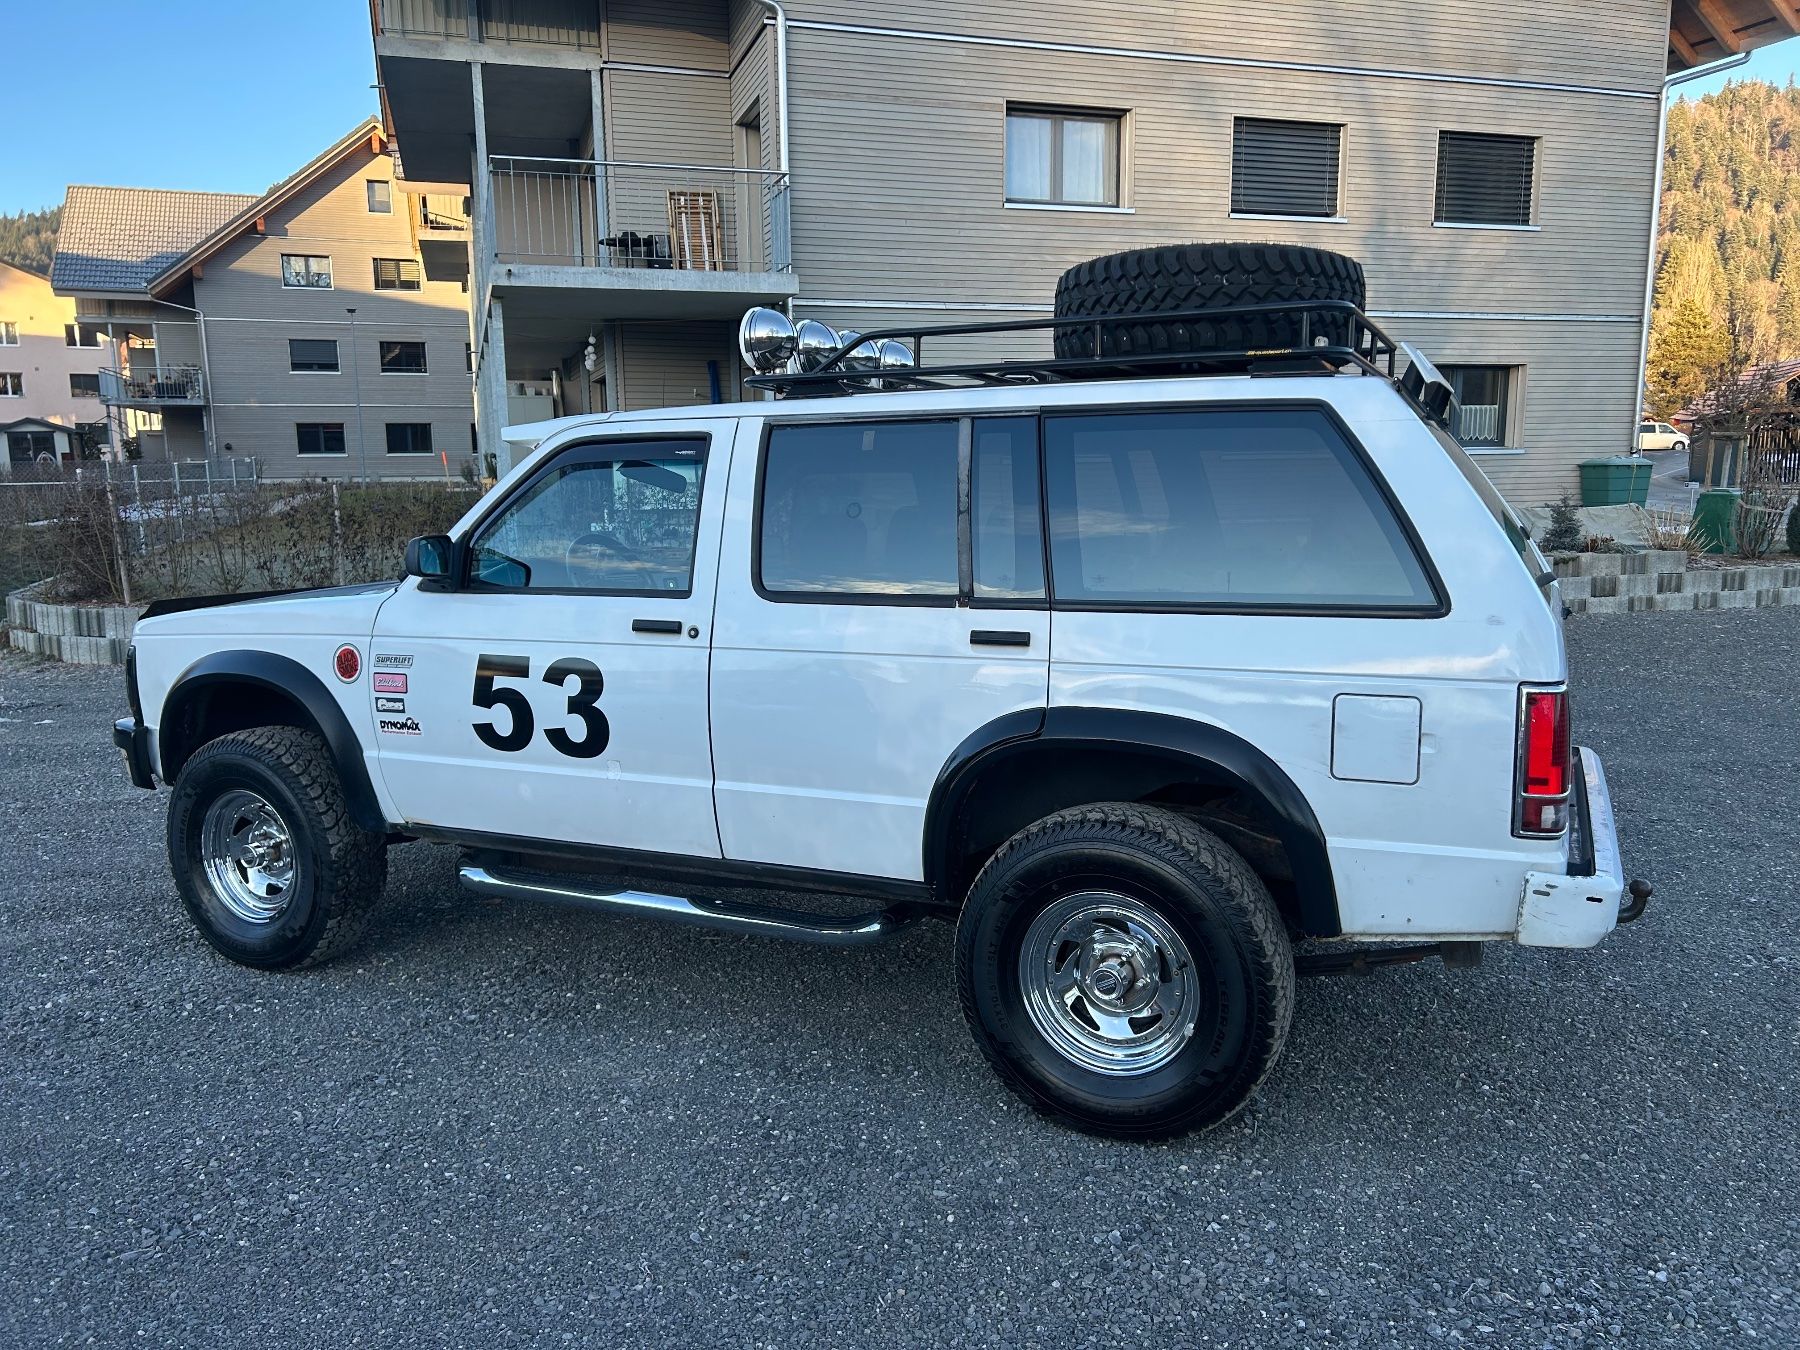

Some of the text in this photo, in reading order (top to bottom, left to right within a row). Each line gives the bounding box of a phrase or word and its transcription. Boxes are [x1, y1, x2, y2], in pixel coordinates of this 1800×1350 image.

[375, 656, 412, 664] SUPERLIFT
[472, 654, 610, 758] 53
[380, 717, 421, 731] DYNOMAX
